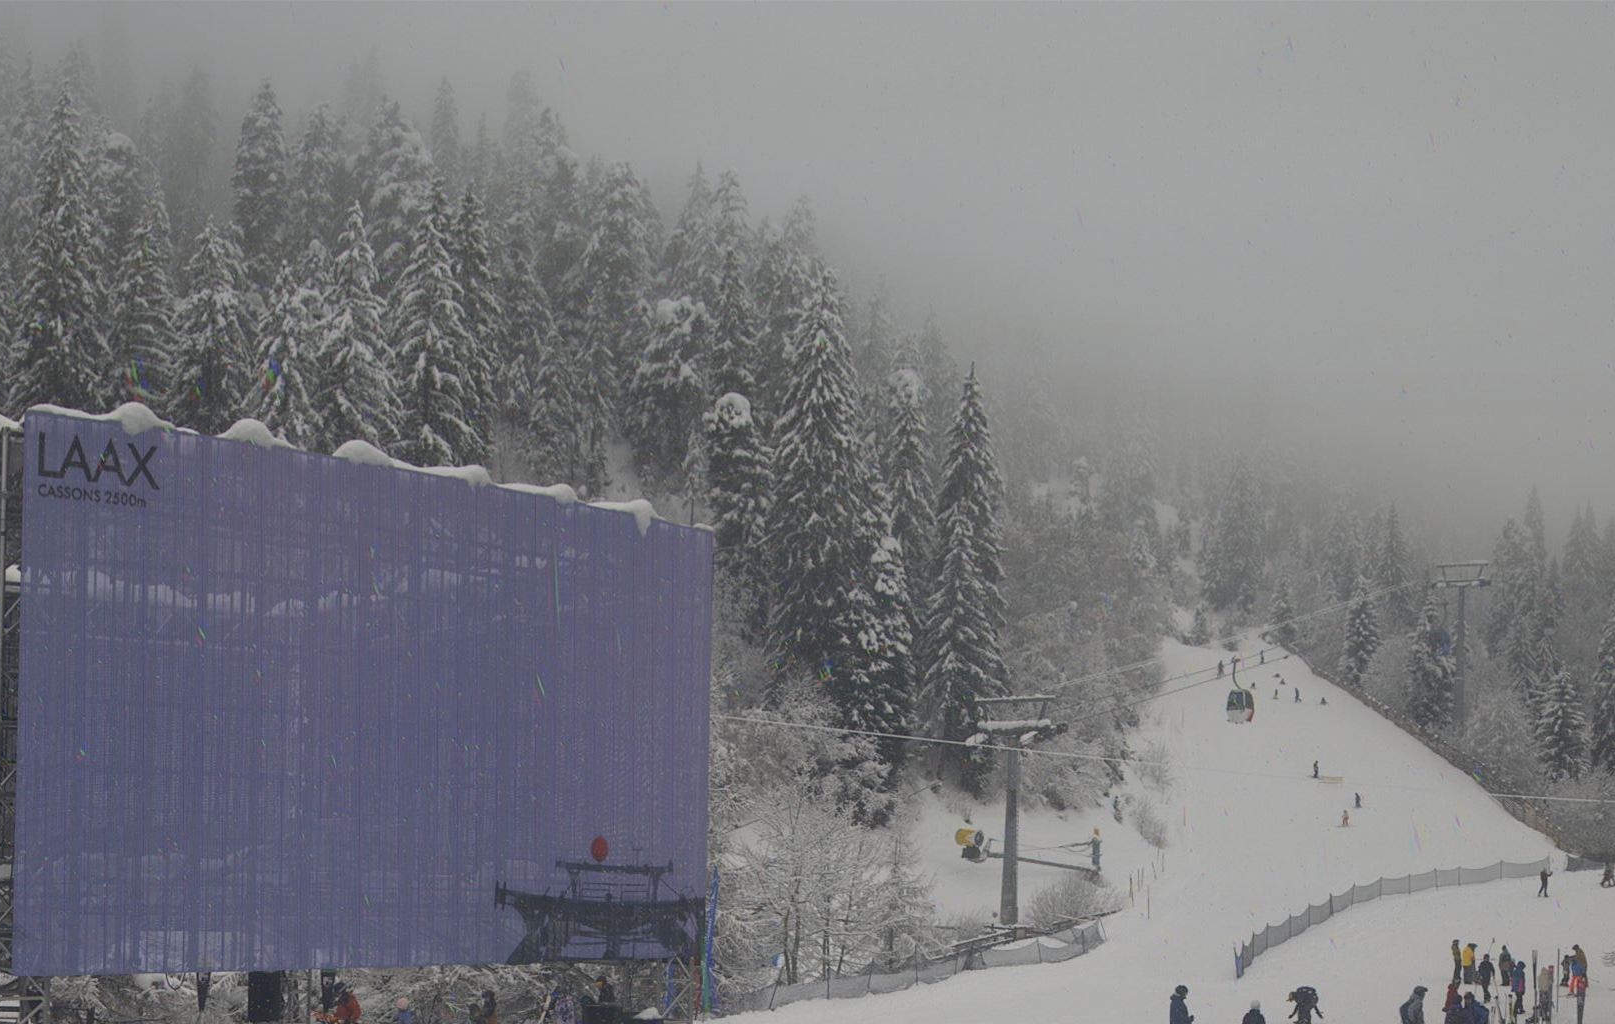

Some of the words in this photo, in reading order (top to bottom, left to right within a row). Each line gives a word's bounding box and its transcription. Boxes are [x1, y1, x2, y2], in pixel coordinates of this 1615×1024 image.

[38, 431, 160, 490] LAAX
[37, 483, 101, 503] CASSONS
[104, 490, 147, 508] 2500m
